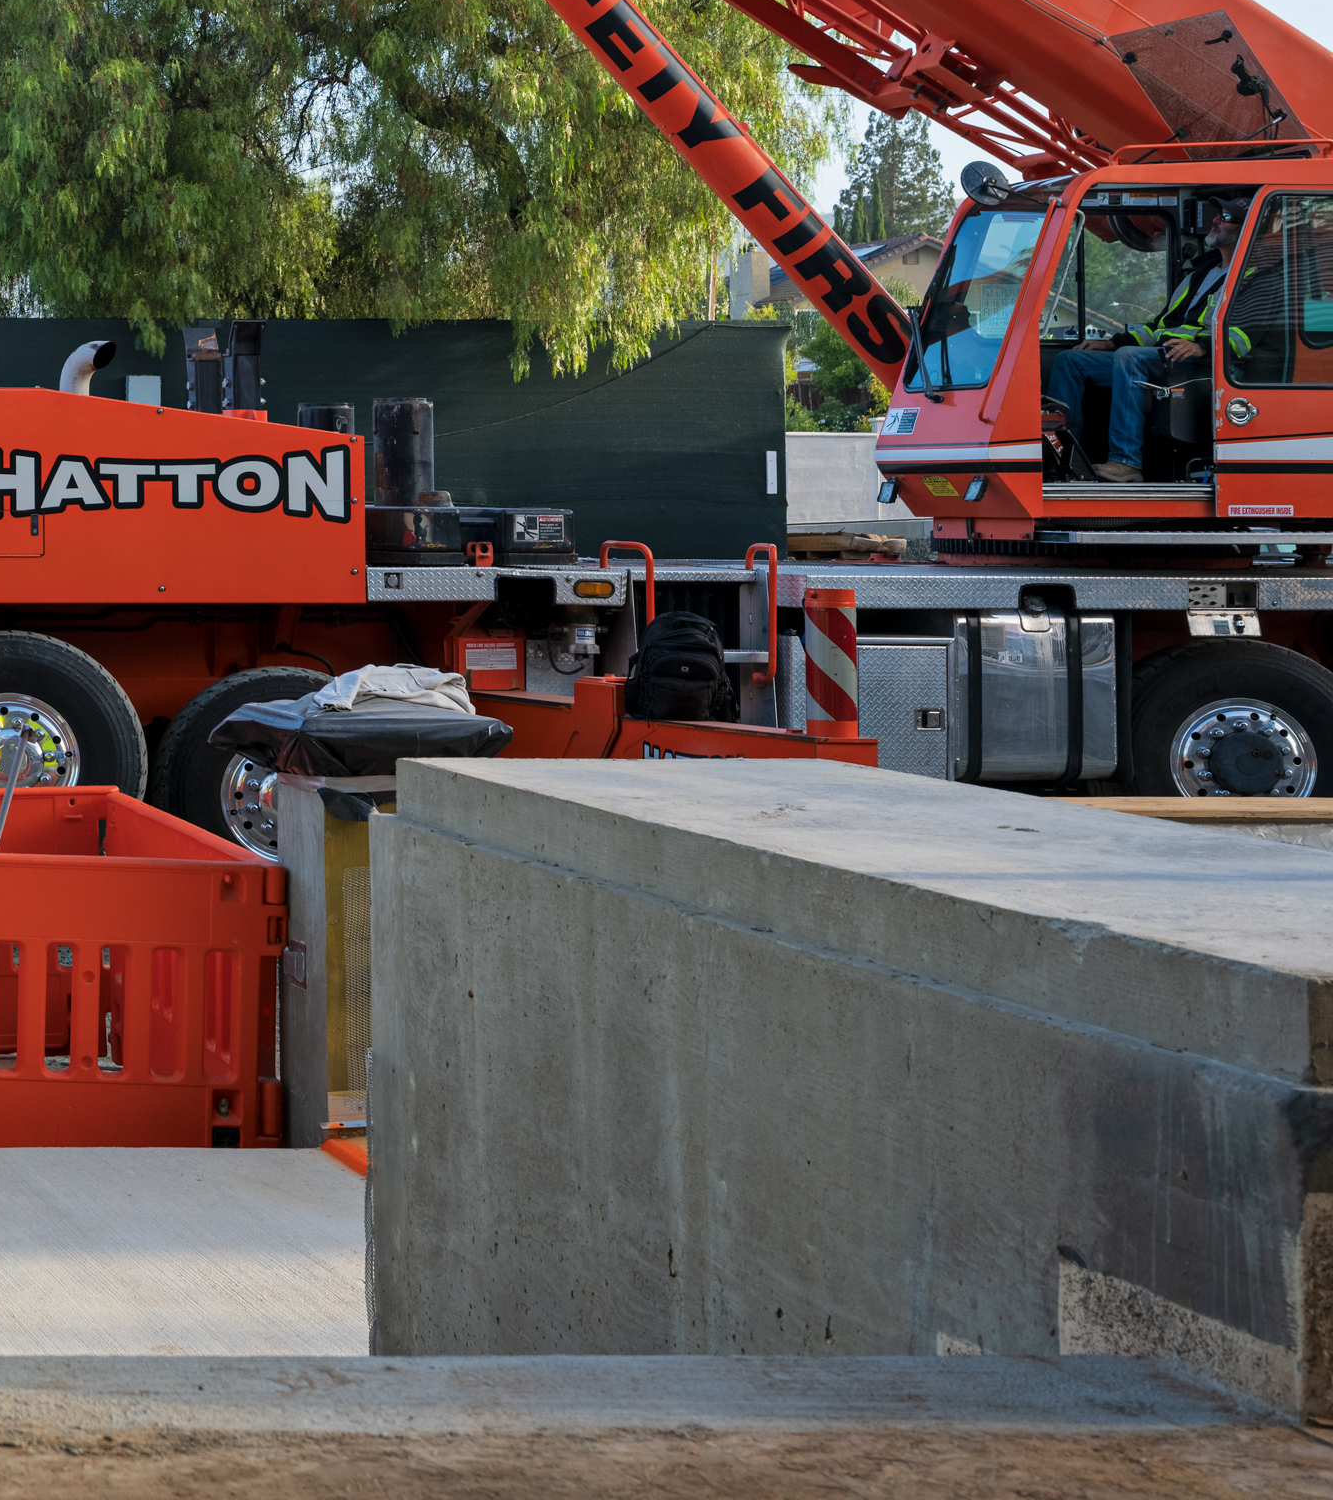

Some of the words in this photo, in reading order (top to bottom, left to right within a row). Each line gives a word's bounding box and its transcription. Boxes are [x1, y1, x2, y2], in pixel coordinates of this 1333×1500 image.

[1230, 507, 1241, 515] FIRE
[1242, 507, 1275, 515] EXTINGUISHER
[1276, 507, 1292, 515] INSIDE
